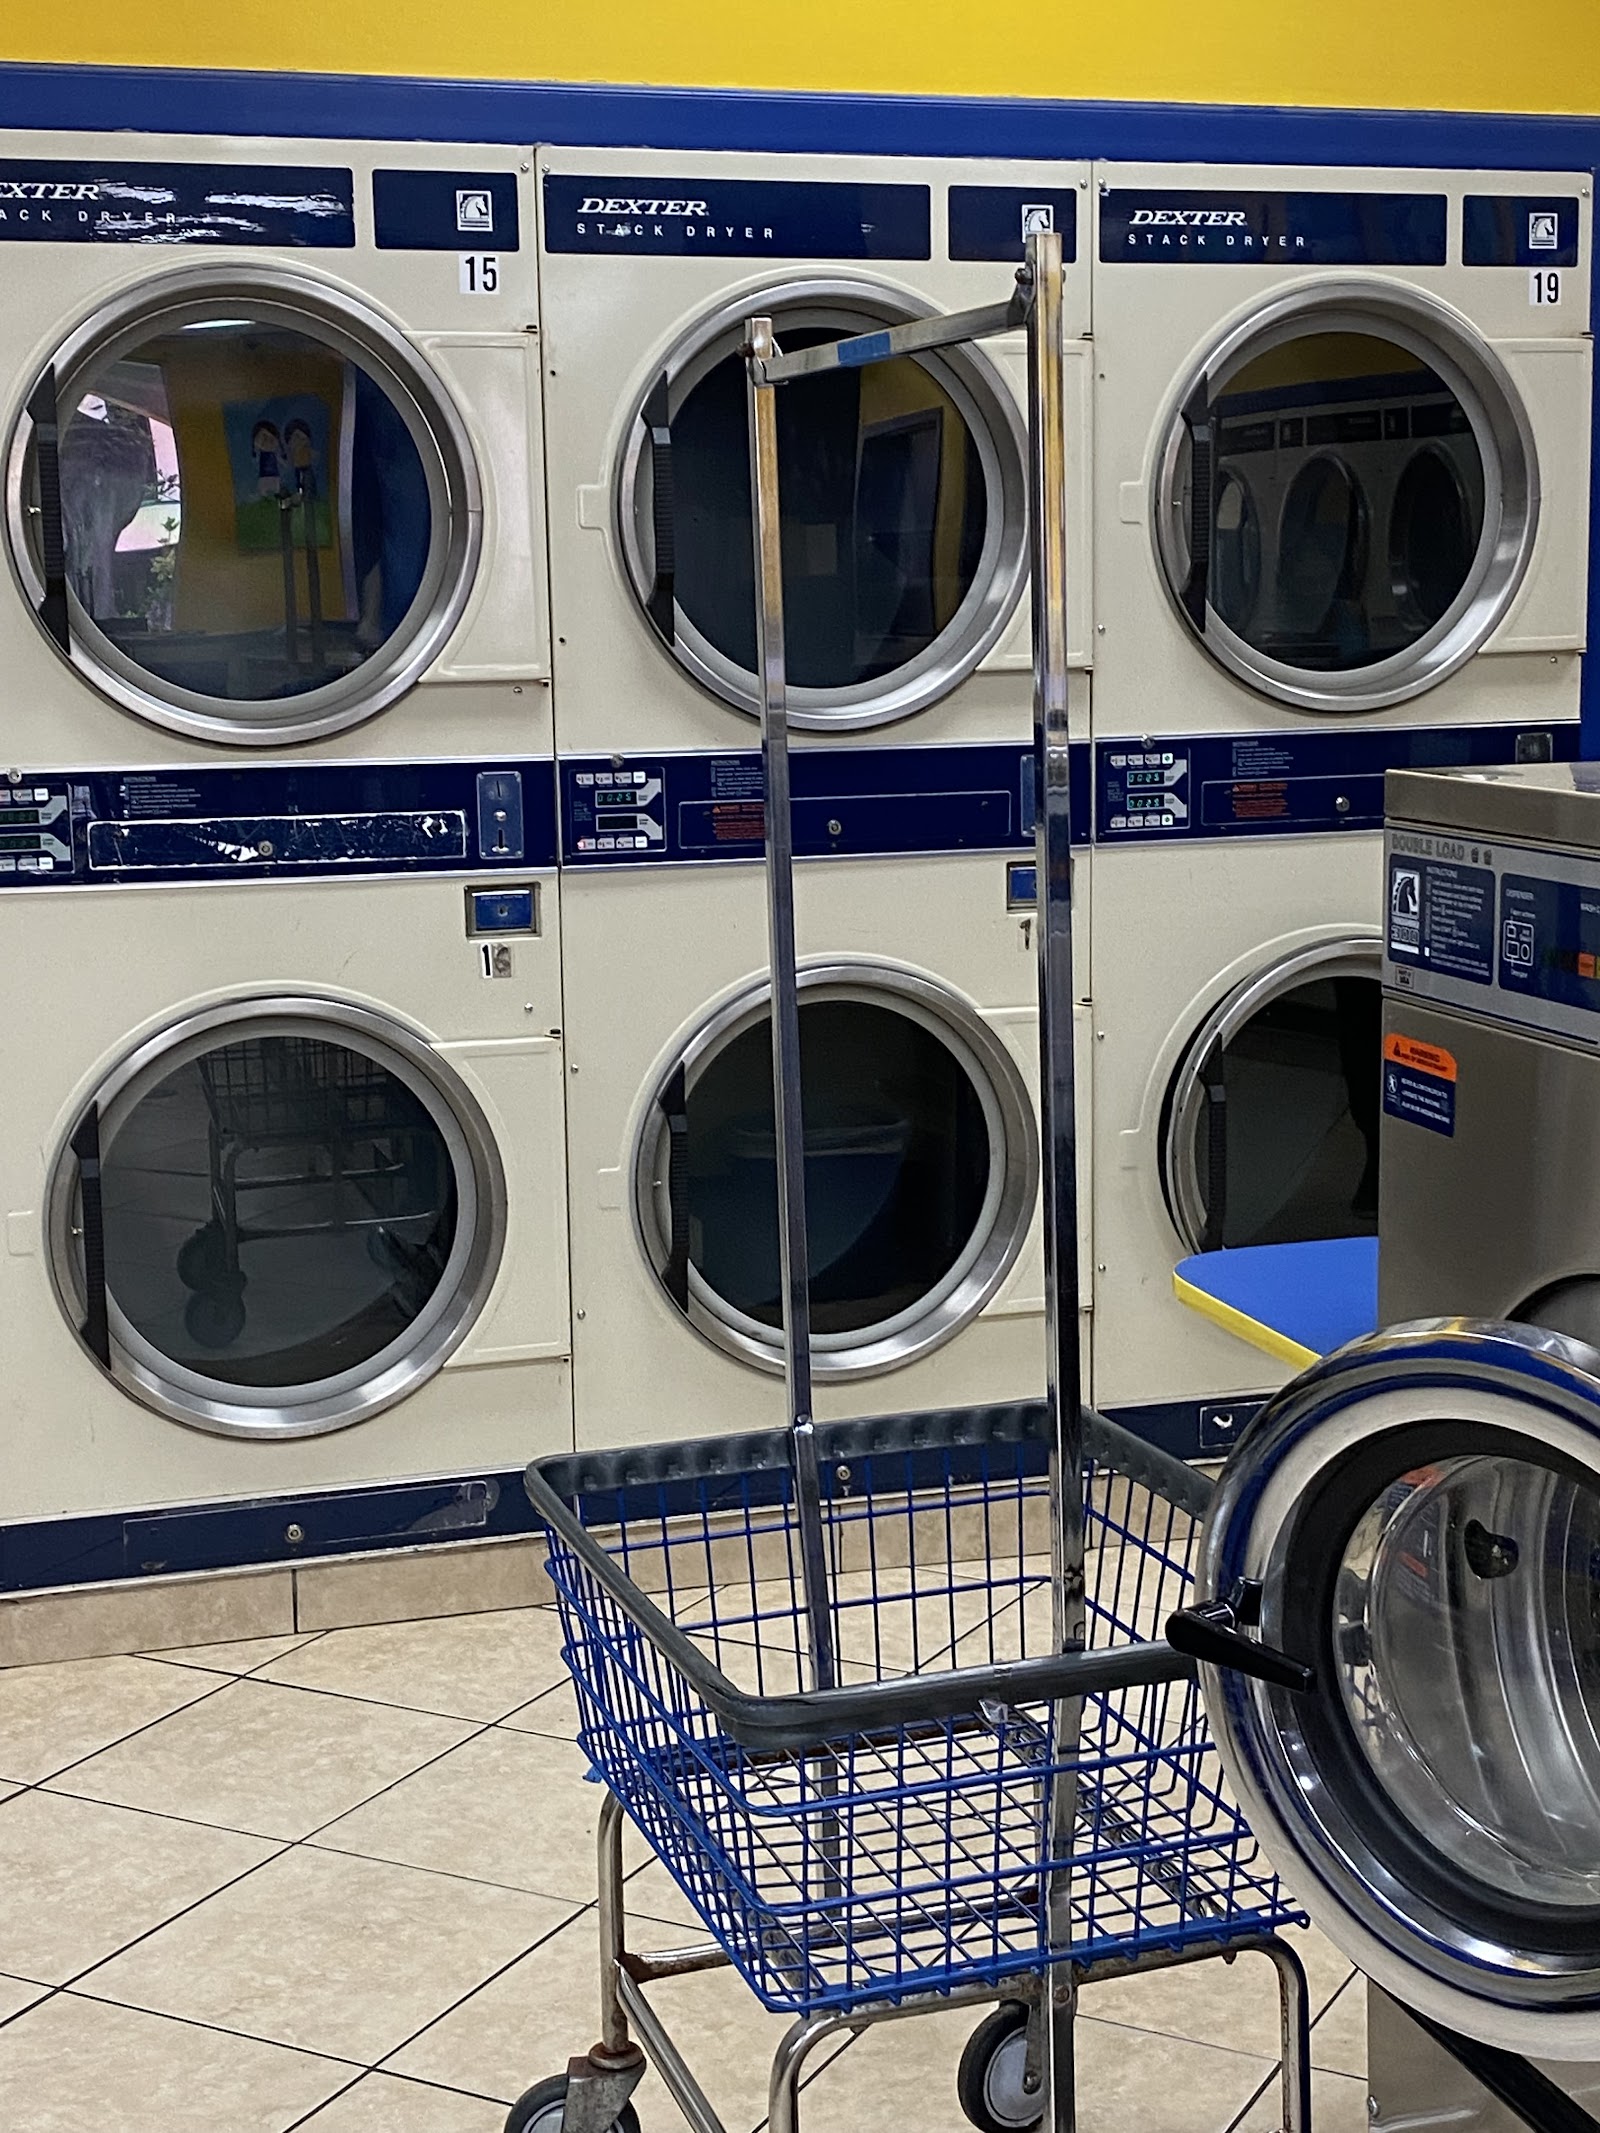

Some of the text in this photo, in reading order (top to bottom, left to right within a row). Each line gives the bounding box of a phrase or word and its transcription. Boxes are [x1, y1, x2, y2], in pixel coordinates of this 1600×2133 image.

[78, 210, 176, 224] DRYER
[576, 197, 709, 217] DEXTER
[1128, 209, 1246, 227] DEXTER
[576, 222, 775, 239] STACK DRYER
[1128, 233, 1306, 247] STACK DRYER
[464, 256, 498, 292] 15
[1532, 272, 1560, 304] 19
[1391, 833, 1465, 861] DOUBLE LOAD
[1390, 924, 1420, 945] 300
